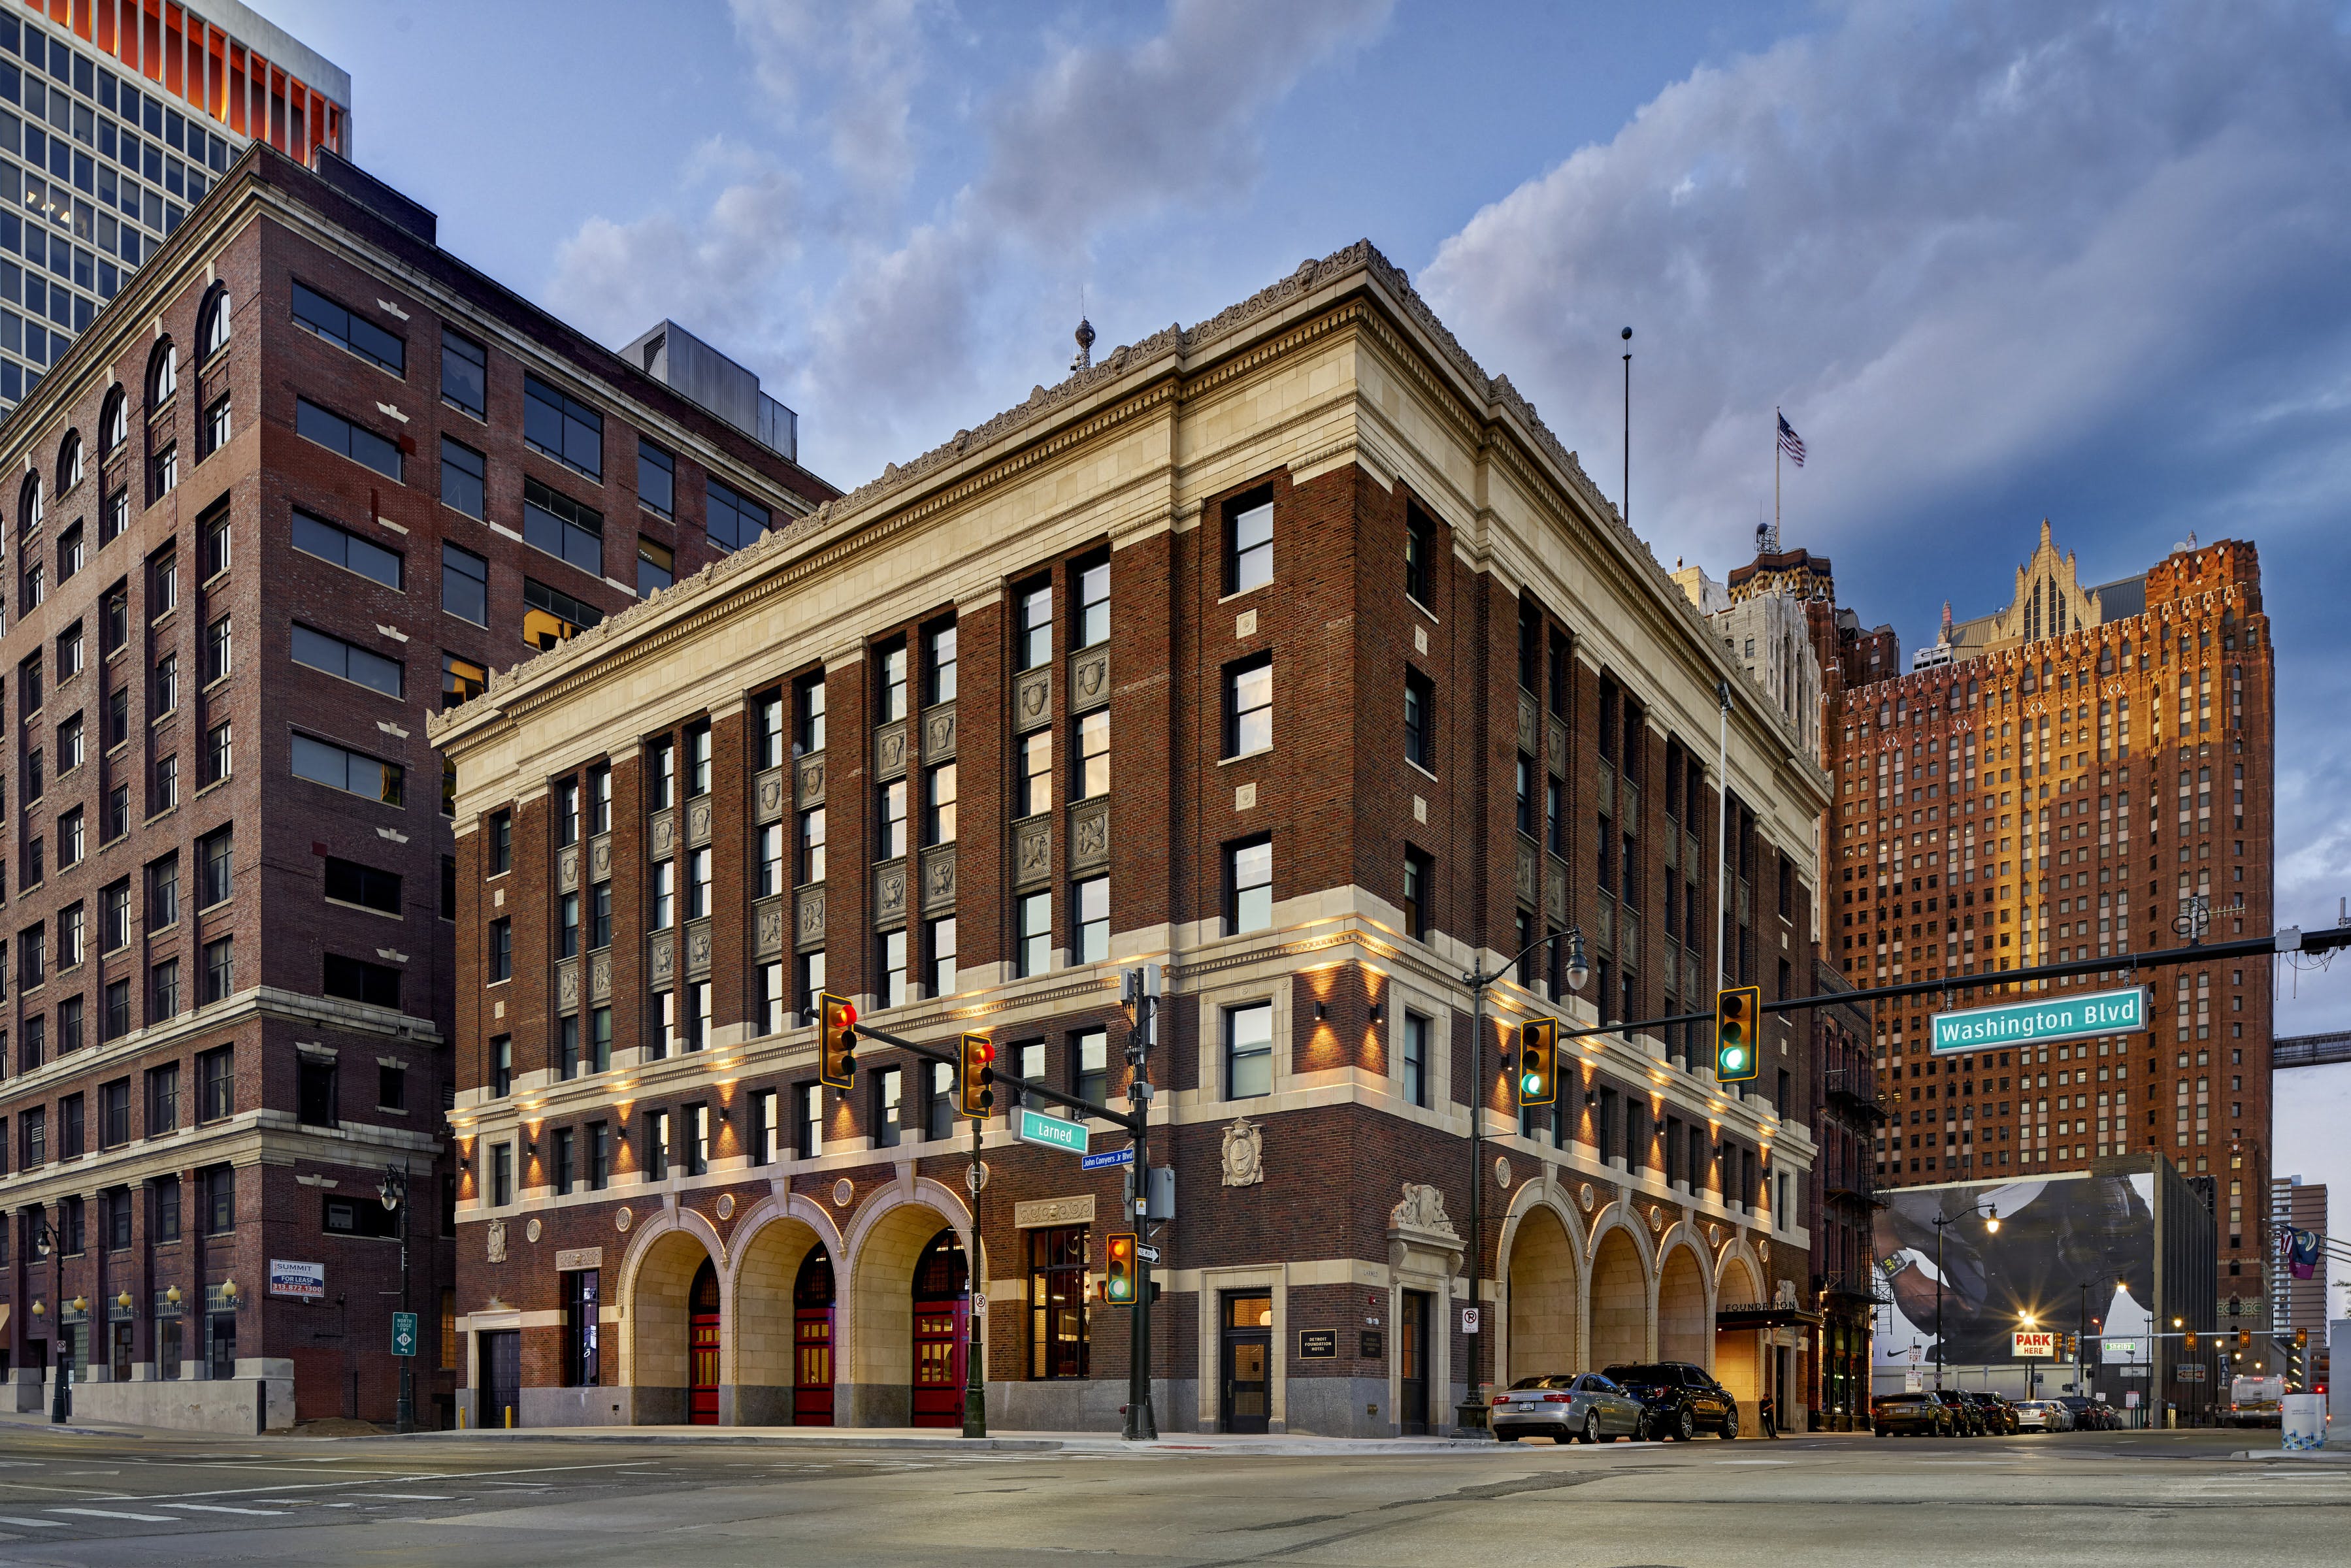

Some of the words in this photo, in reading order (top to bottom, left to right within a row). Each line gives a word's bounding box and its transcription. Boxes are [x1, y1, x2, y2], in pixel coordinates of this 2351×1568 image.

[1942, 1011, 2072, 1041] Washington
[2085, 999, 2133, 1024] Blvd
[1039, 1122, 1072, 1143] Larned
[1083, 1158, 1094, 1167] John
[1096, 1155, 1115, 1166] Conyers
[1116, 1152, 1121, 1162] Jr
[1123, 1151, 1132, 1160] Blvd
[272, 1283, 322, 1292] 313.872.1300
[2016, 1334, 2050, 1346] PARK
[1909, 1354, 1920, 1364] FORT
